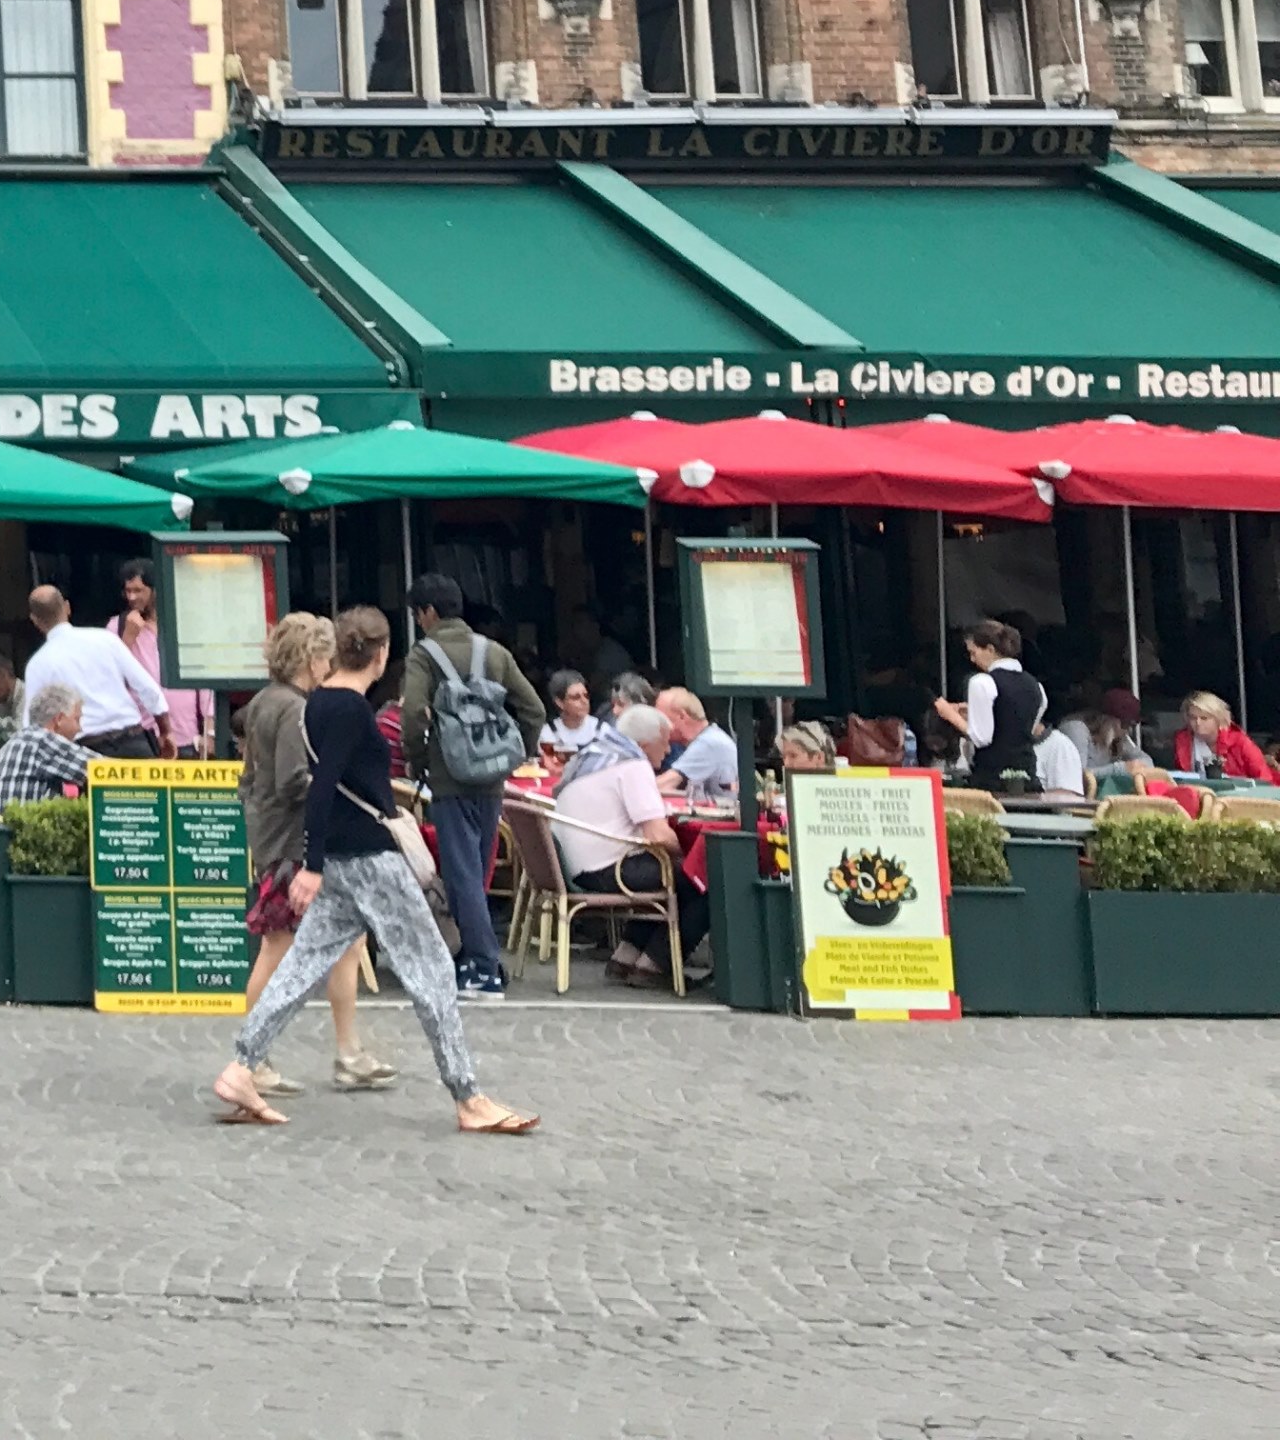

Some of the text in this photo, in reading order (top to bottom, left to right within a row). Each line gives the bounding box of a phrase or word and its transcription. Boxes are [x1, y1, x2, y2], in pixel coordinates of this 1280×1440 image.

[277, 125, 1095, 159] RESTAURANT LA CIVIERE D'OR
[549, 358, 752, 393] Brasserie
[790, 361, 839, 393] La
[850, 360, 996, 395] Civiere
[1006, 365, 1094, 398] d'Or
[149, 394, 323, 438] ARTS
[93, 765, 241, 782] CAFE DES ARTS
[815, 786, 912, 800] MOSSELEN FRIET
[819, 799, 910, 812] MOULES FRITES
[820, 812, 910, 825] MUSSELS FRIES
[882, 824, 926, 838] PATATAS
